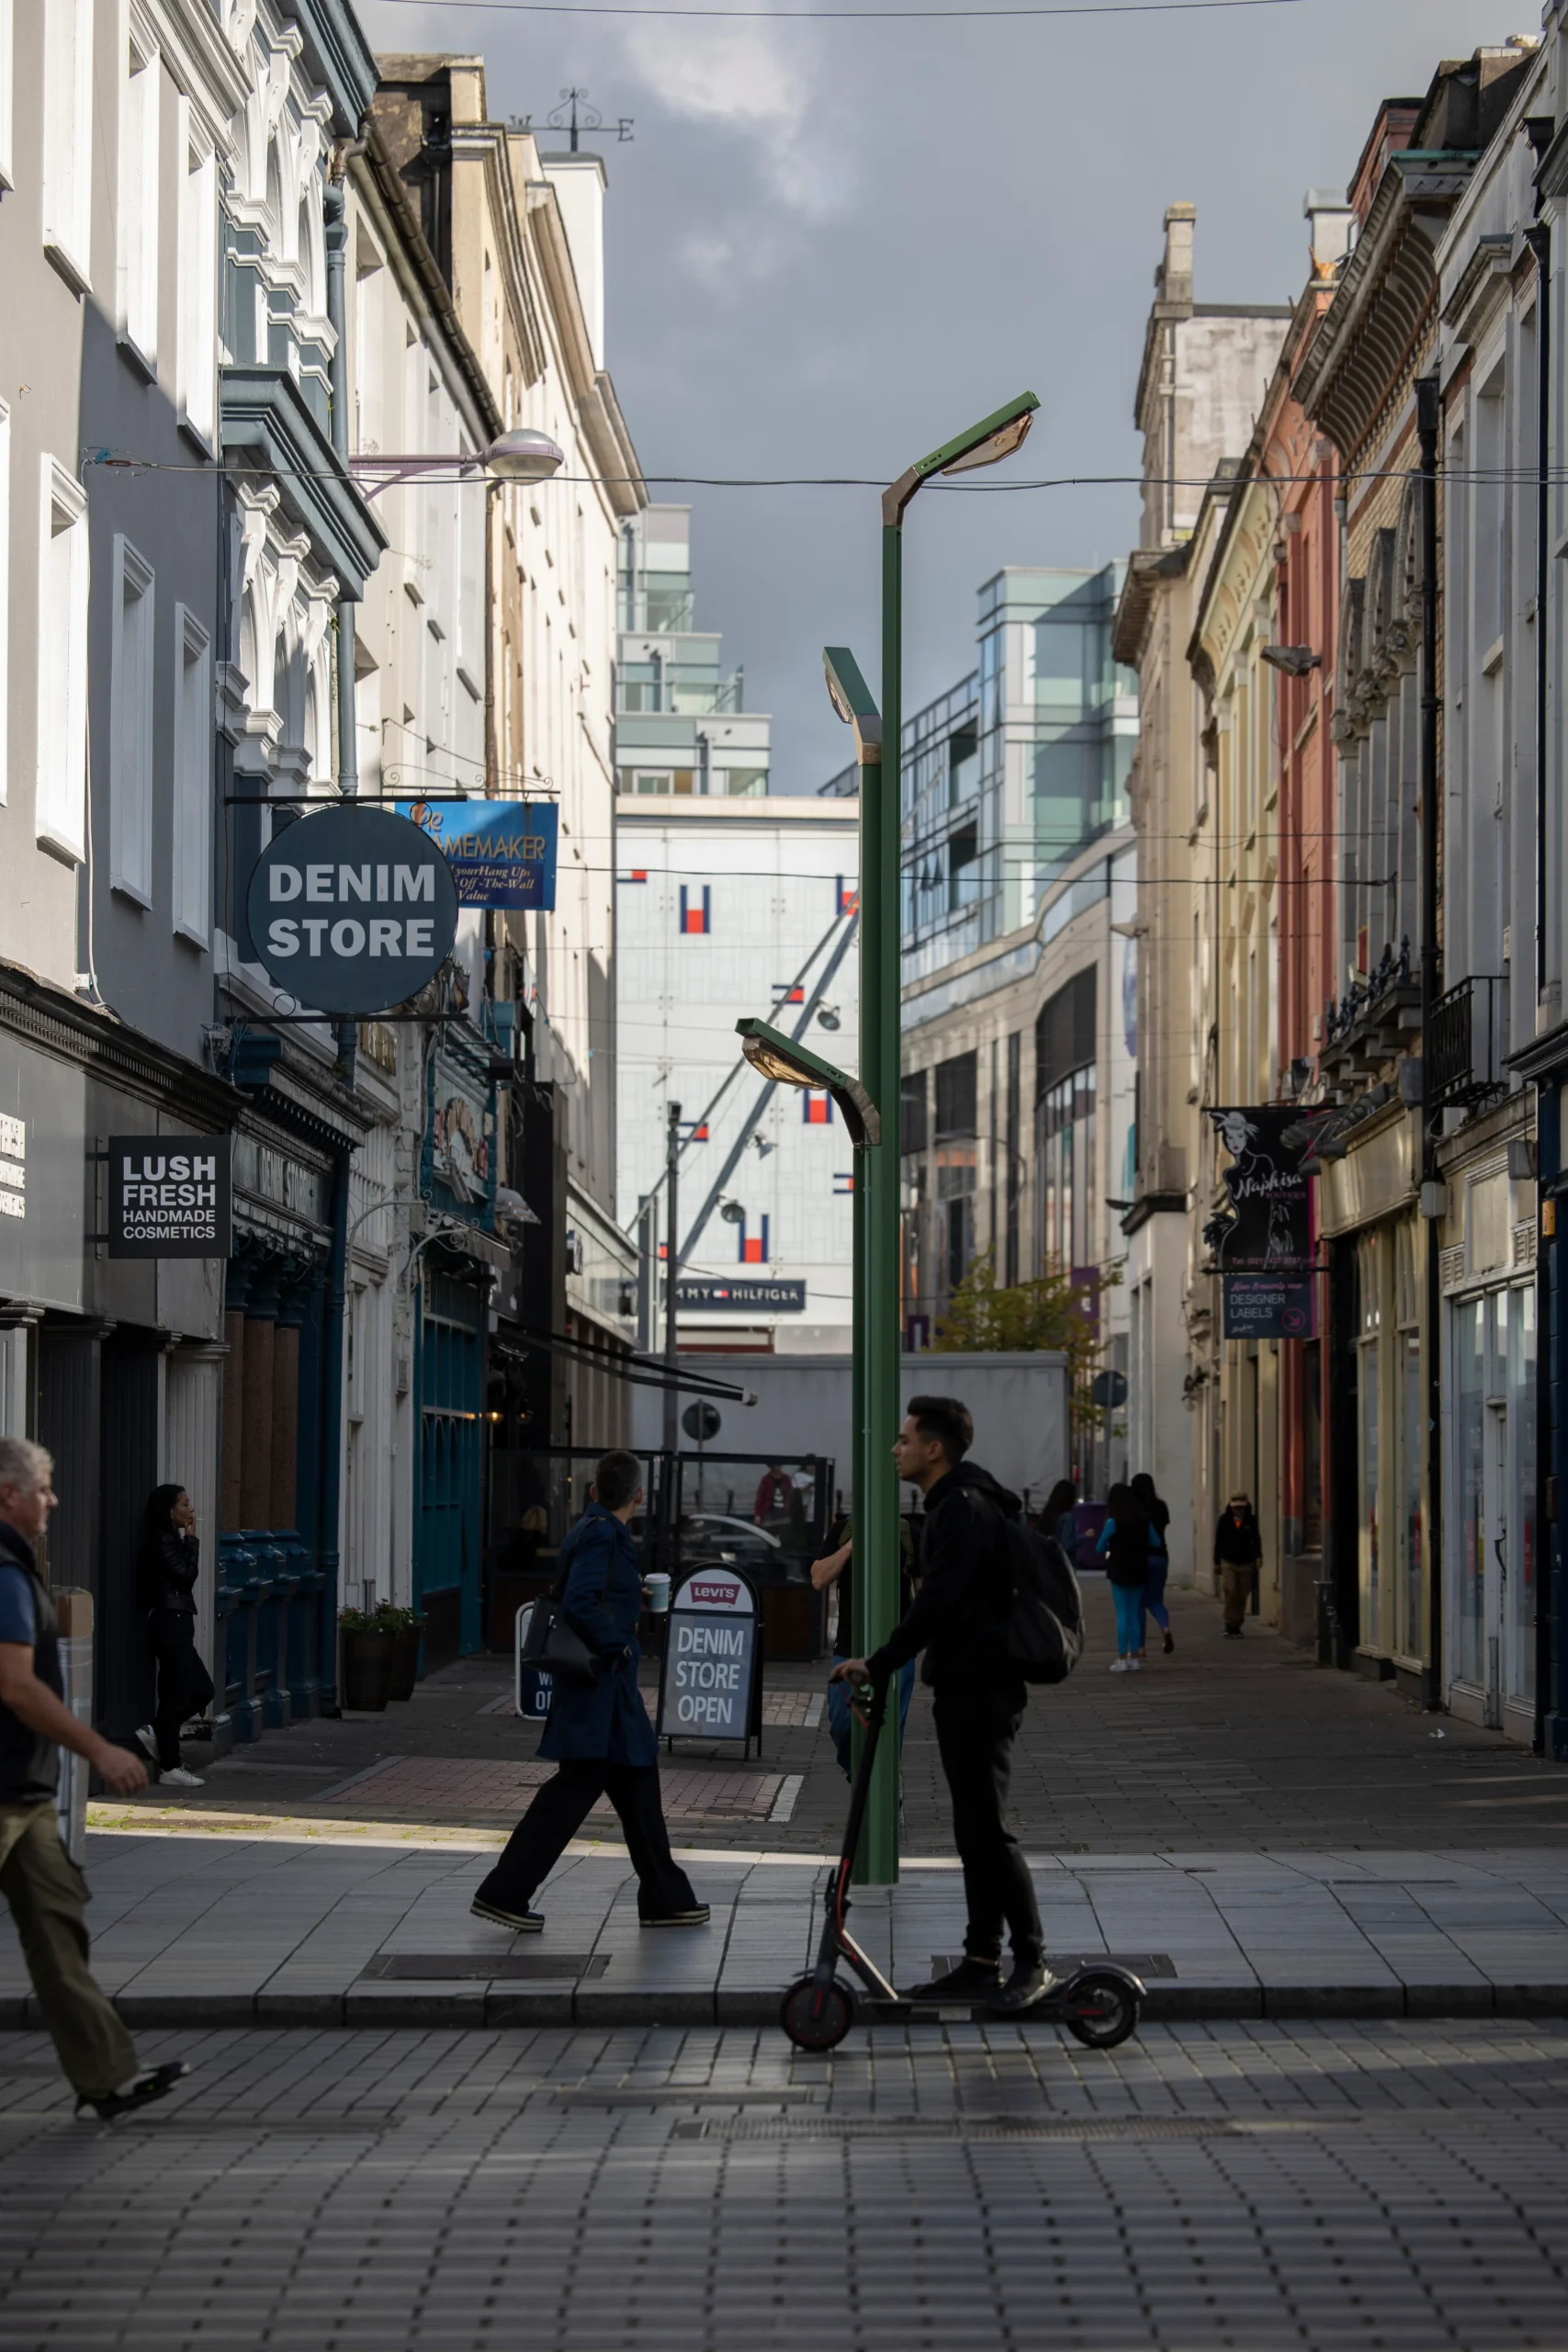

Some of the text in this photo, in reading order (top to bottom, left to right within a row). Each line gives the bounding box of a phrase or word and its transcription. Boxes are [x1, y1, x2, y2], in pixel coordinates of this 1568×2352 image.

[433, 833, 547, 860] AMEMAKER
[511, 866, 531, 879] Ups
[269, 864, 435, 902] DENIM
[460, 876, 479, 890] Off
[458, 889, 490, 901] Value
[266, 919, 434, 957] STORE
[123, 1156, 216, 1182] LUSH
[123, 1184, 216, 1206] FRESH
[123, 1210, 216, 1223] HANDMADE
[123, 1227, 216, 1239] COSMETICS
[675, 1287, 799, 1301] MMY HILFIGER
[1230, 1294, 1286, 1306] DESIGNER
[1231, 1306, 1273, 1318] LABELS
[677, 1626, 745, 1656] DENIM
[675, 1660, 740, 1690] STORE
[677, 1695, 733, 1724] OPEN
